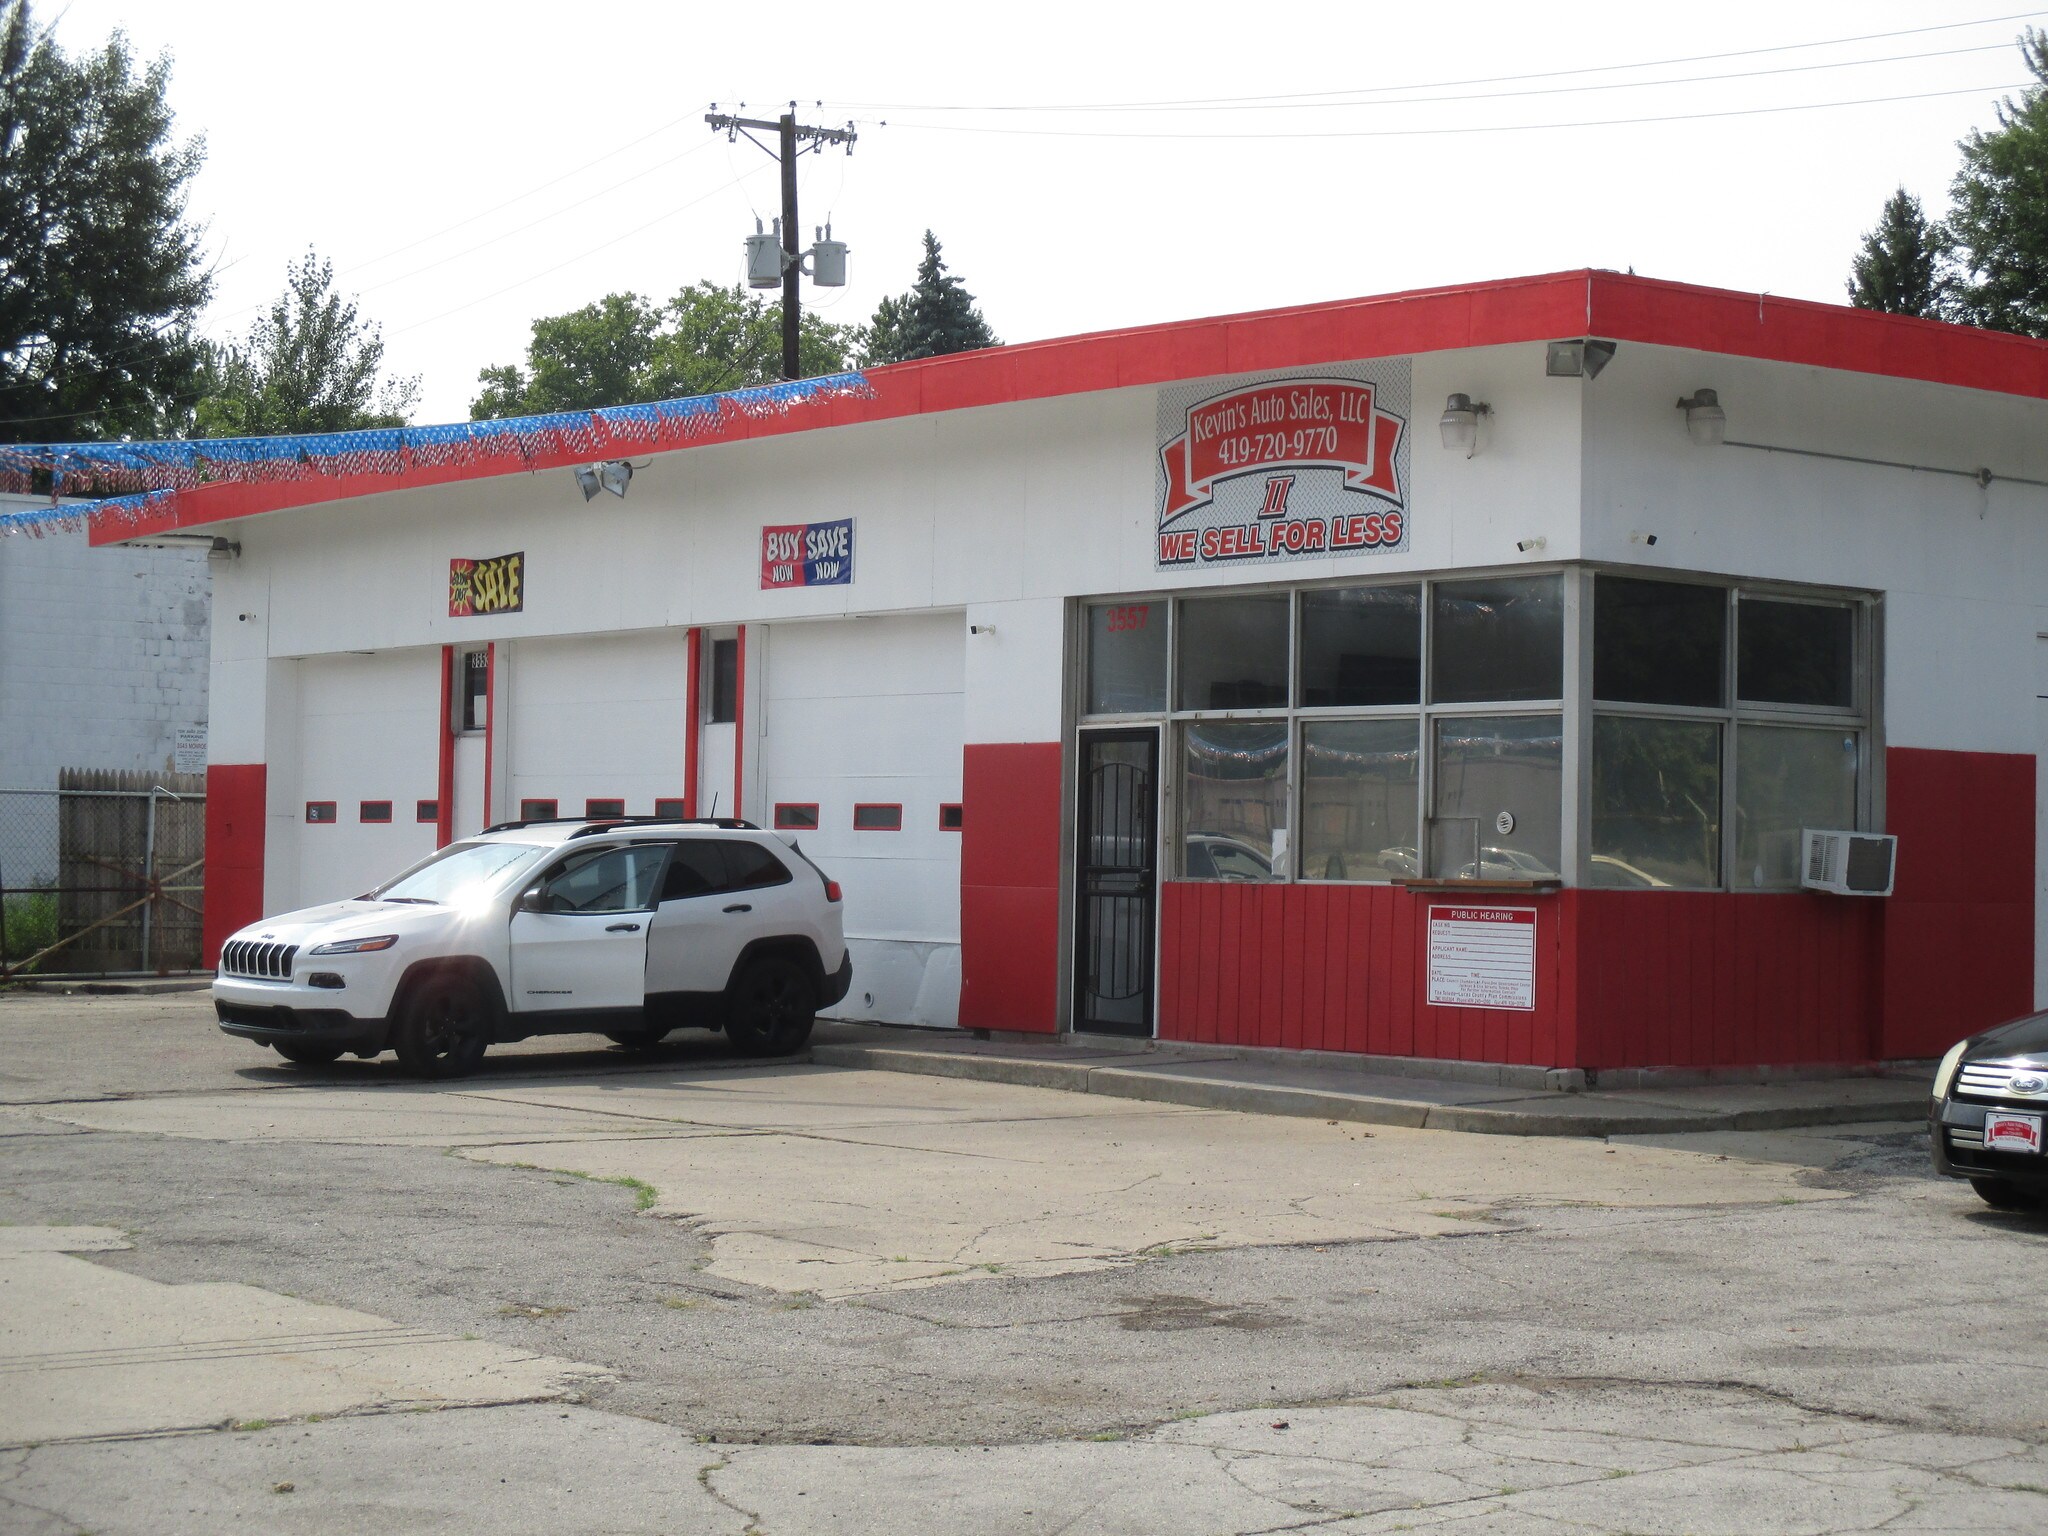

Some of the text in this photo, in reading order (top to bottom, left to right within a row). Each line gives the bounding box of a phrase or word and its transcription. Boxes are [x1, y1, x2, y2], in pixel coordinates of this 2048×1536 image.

[1193, 388, 1368, 443] Kevin's Auto Sales, LLC
[1218, 425, 1338, 465] 419-720-9770
[1258, 475, 1296, 519] II
[767, 526, 849, 562] BUY SAVE
[1159, 511, 1404, 564] WE SELL FOR LESS
[473, 556, 520, 612] SALE
[772, 561, 840, 583] NOW NOW
[1105, 605, 1149, 633] 3557
[1451, 910, 1514, 921] PUBLIC HEARING
